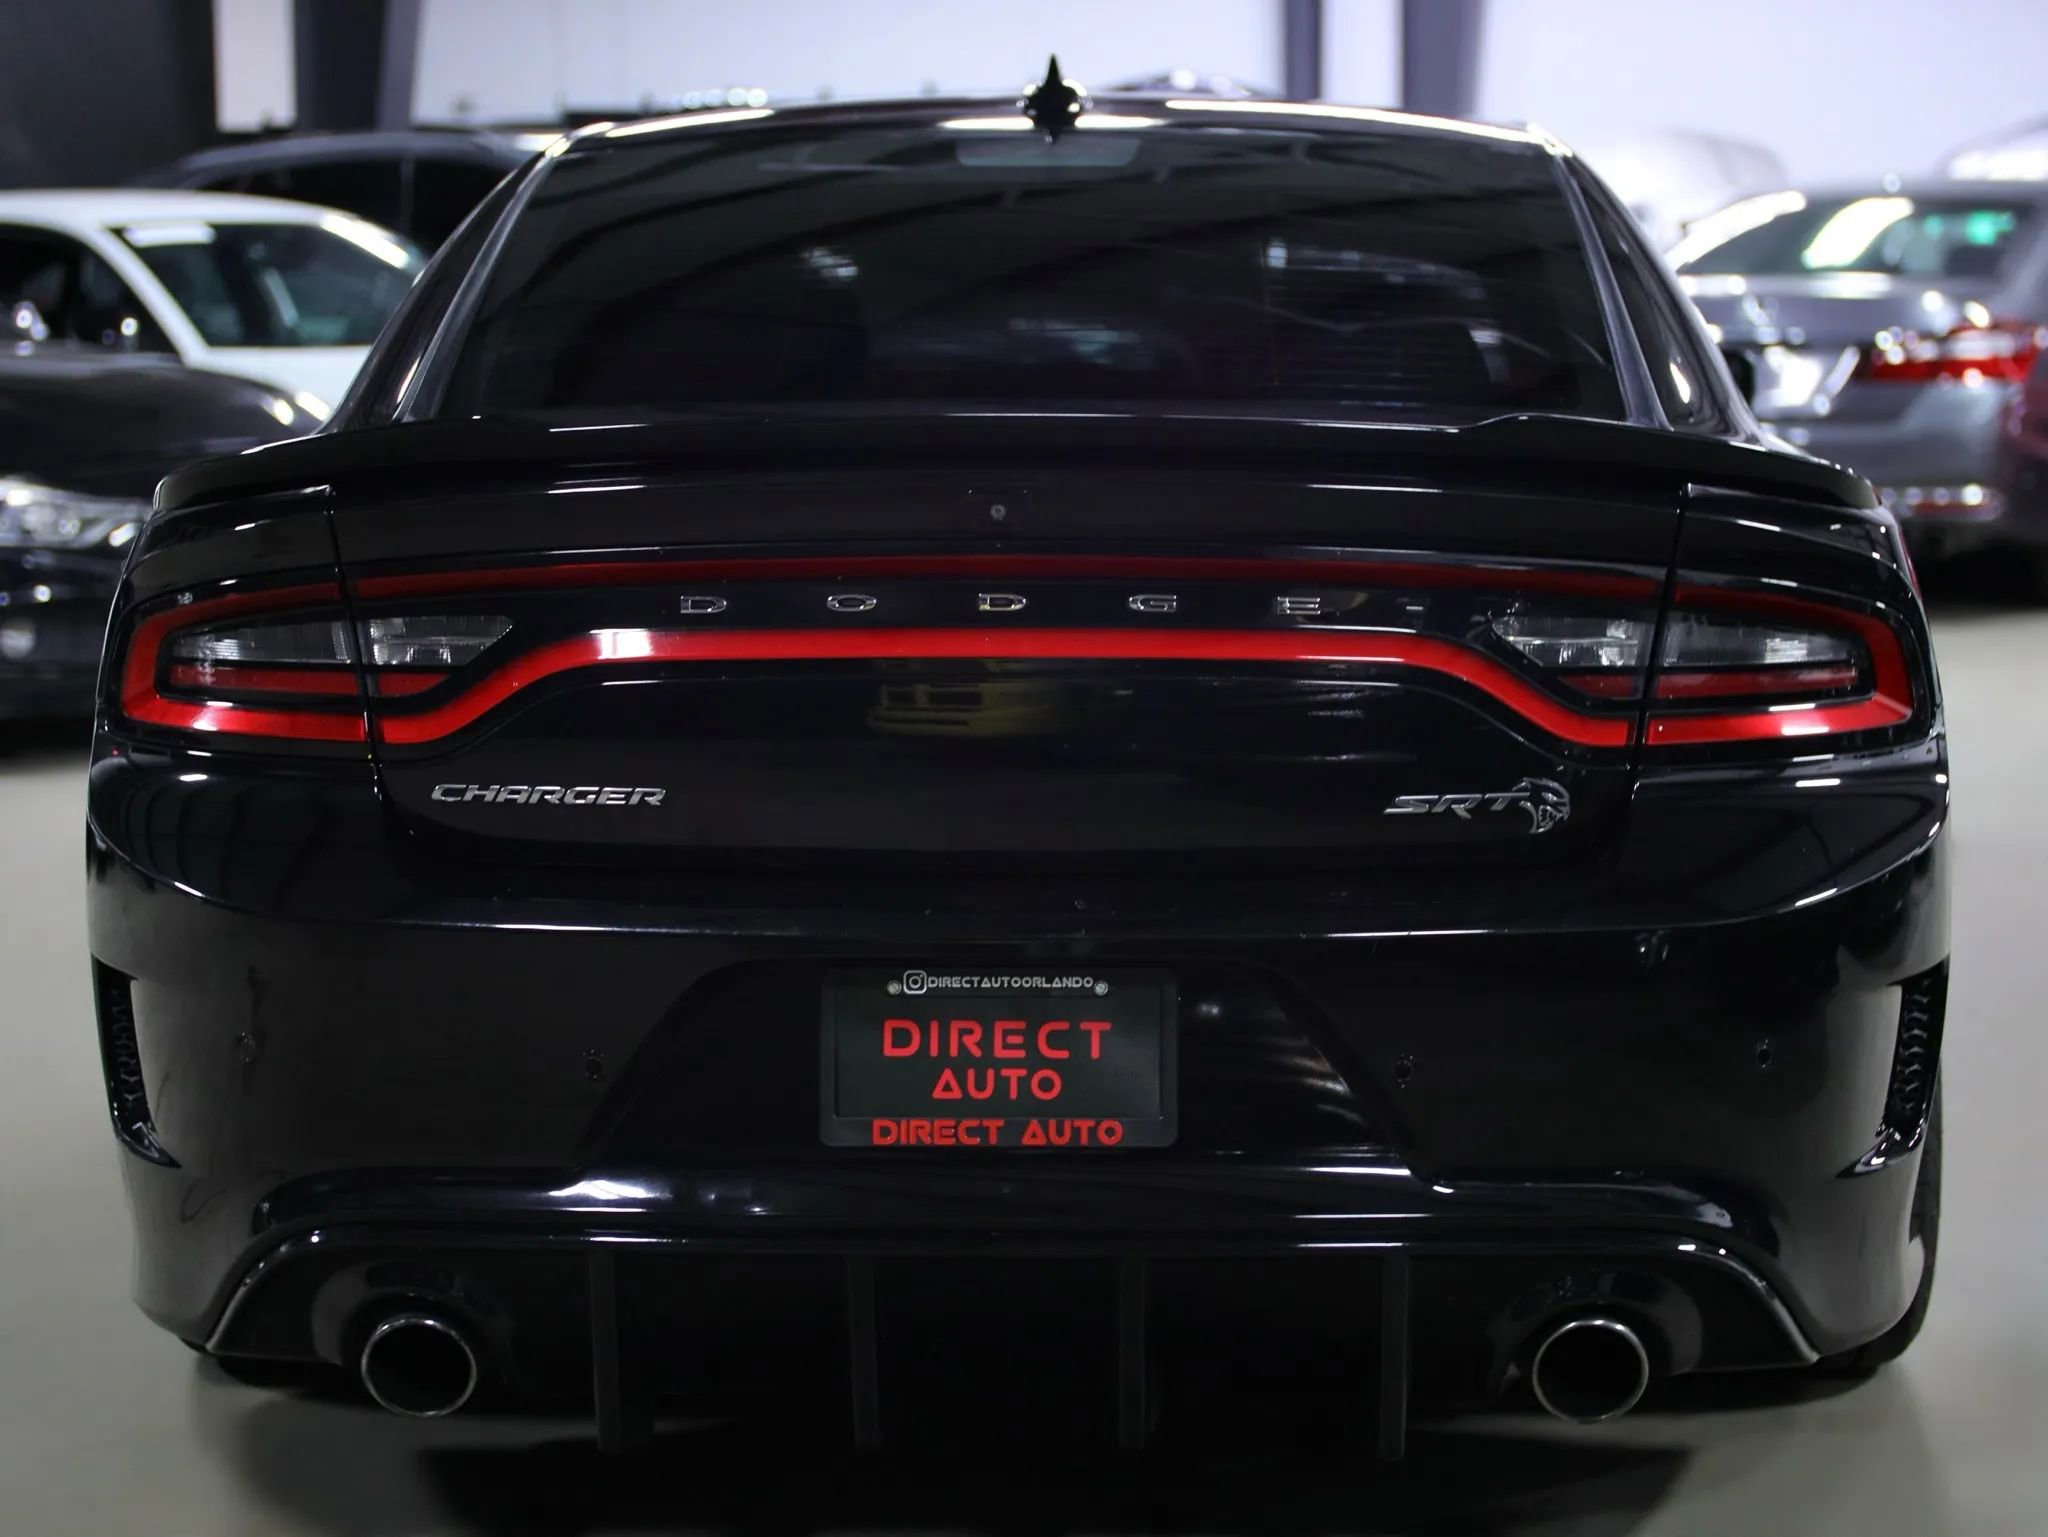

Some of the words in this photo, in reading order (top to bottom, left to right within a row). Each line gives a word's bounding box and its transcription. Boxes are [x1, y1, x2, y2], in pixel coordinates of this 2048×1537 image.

[679, 594, 1321, 615] DODGE
[431, 784, 667, 806] CHARGER
[1383, 792, 1531, 819] SRT
[927, 976, 1094, 988] DIRECTAUTOORLANDO
[883, 1019, 1112, 1060] DIRECT
[931, 1067, 1062, 1100] AUTO
[872, 1119, 1005, 1146] DIRECT
[1021, 1119, 1124, 1146] AUTO
